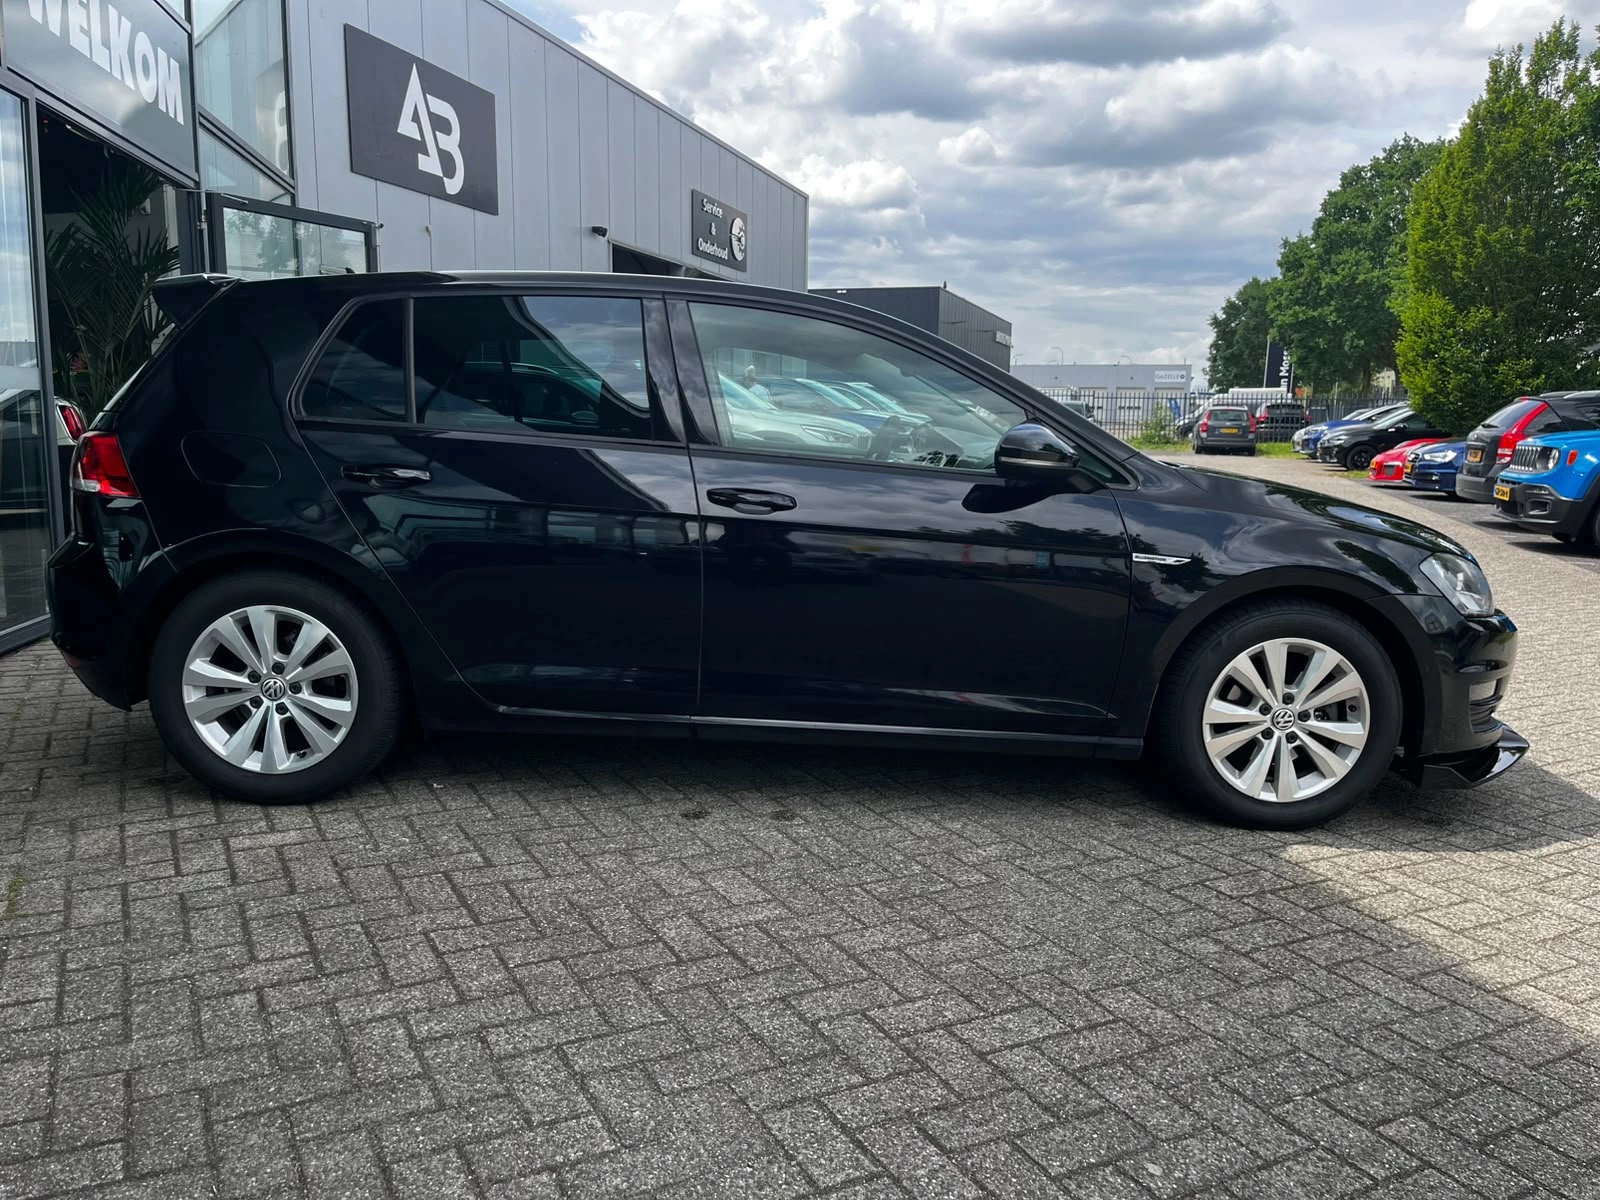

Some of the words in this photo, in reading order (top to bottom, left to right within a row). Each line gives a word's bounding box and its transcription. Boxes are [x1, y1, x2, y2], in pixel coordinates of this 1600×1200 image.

[702, 198, 723, 218] Service
[710, 222, 717, 236] &
[698, 237, 728, 260] Onderhoud
[1279, 346, 1290, 376] Moss
